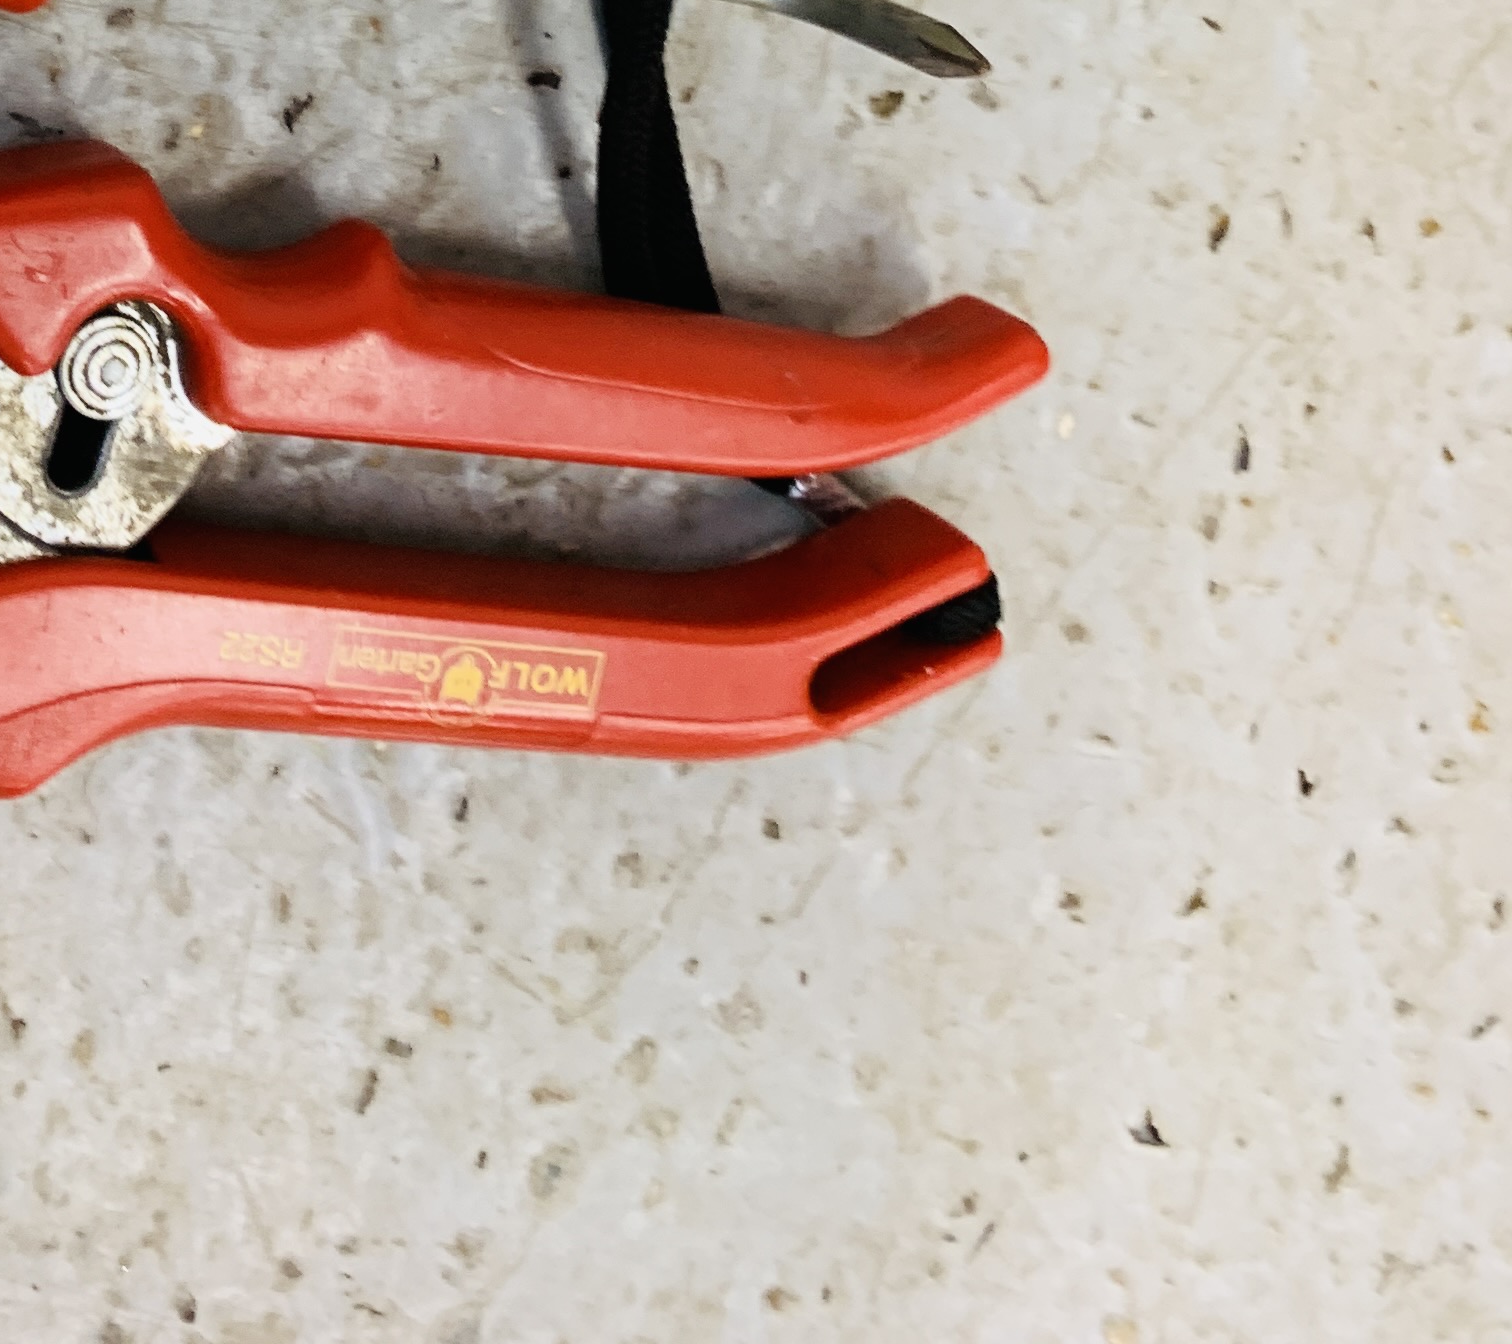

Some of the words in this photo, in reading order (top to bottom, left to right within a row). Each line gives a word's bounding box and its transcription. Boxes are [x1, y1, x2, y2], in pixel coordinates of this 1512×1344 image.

[218, 631, 305, 671] RS22
[335, 644, 443, 683] Garten
[490, 659, 590, 698] WOLF
